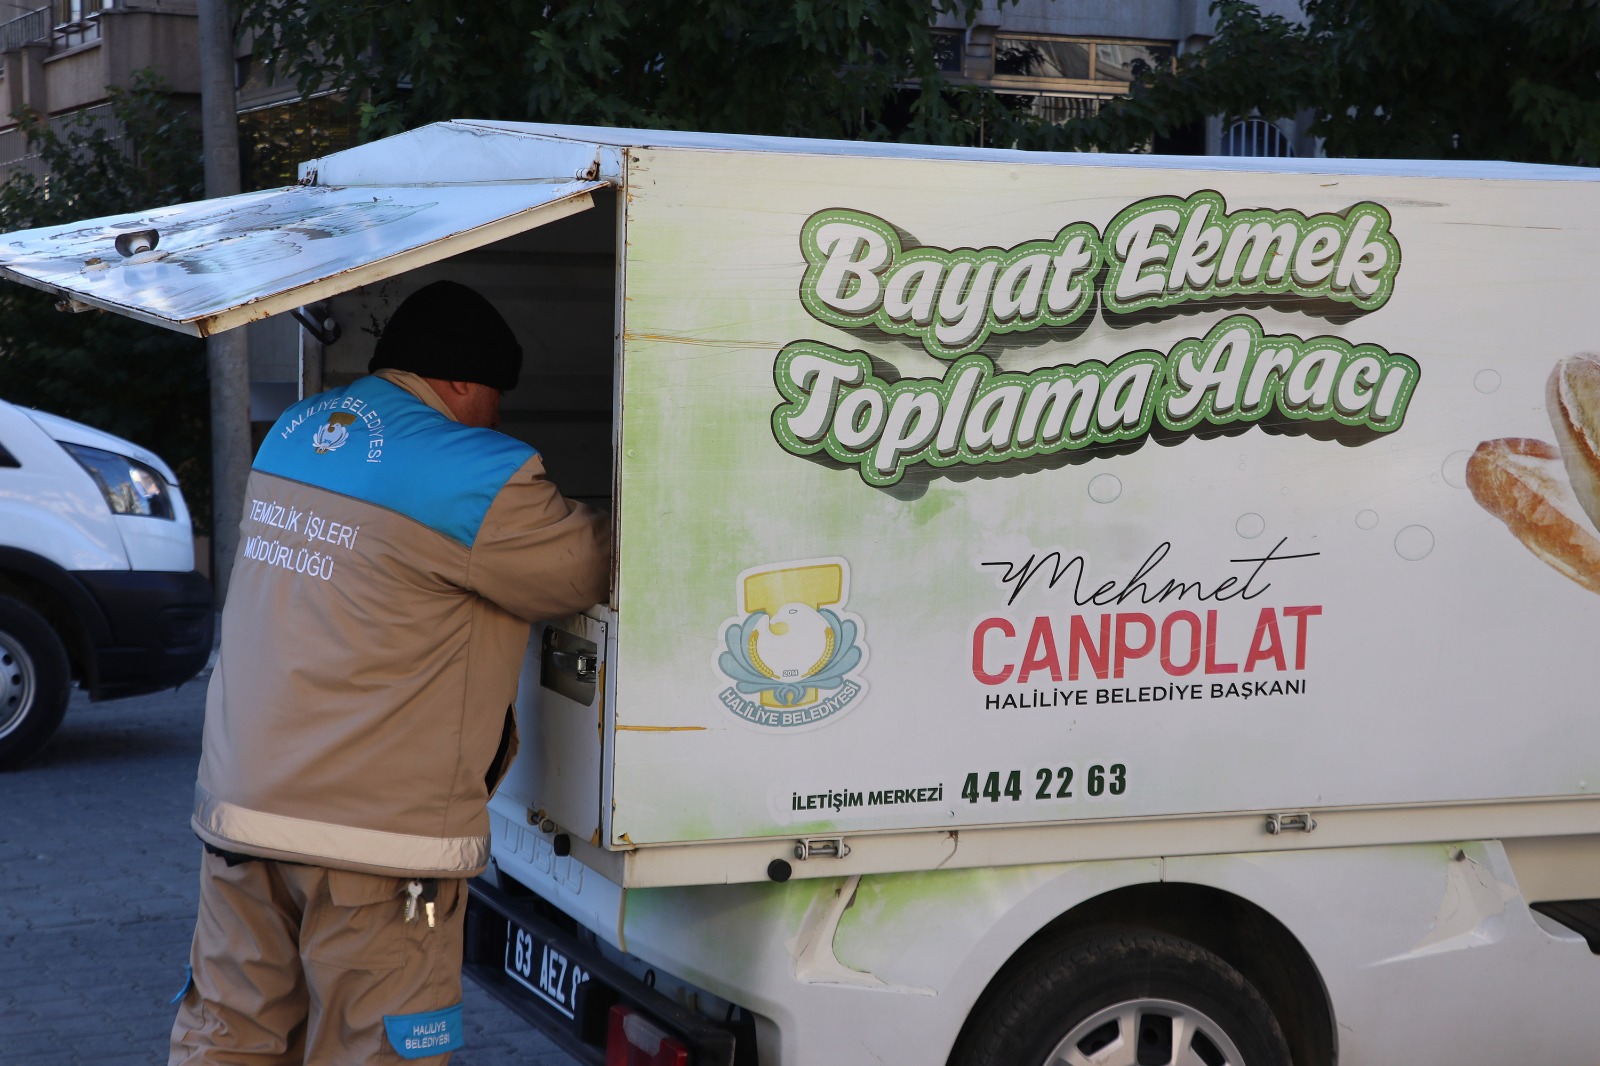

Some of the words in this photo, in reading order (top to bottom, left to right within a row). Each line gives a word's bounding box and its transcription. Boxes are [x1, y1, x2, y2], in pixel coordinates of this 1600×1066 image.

[813, 221, 1092, 344] Bayat
[1113, 202, 1390, 299] Ekmek
[341, 396, 385, 463] BELEDİYESİ
[788, 353, 1159, 474] Toplama
[1173, 325, 1408, 421] Aracı
[244, 535, 334, 581] MÜDÜRLÜĞÜ
[250, 500, 302, 532] TEMİZLİK
[304, 511, 360, 550] İŞLERİ
[981, 536, 1320, 606] Mehmet
[972, 605, 1323, 686] CANPOLAT
[720, 688, 780, 726] HALİLİYE
[782, 680, 861, 726] BELEDİYESİ
[985, 688, 1088, 710] HALİLİYE
[1095, 682, 1203, 704] BELEDİYE
[1210, 679, 1307, 700] BAŞKANI
[792, 788, 864, 813] İLETİŞİM
[867, 783, 943, 806] MERKEZİ
[961, 770, 1023, 804] 444
[1035, 766, 1074, 800] 22
[1087, 763, 1127, 797] 63
[514, 928, 533, 978] 63
[539, 945, 568, 1004] AEZ
